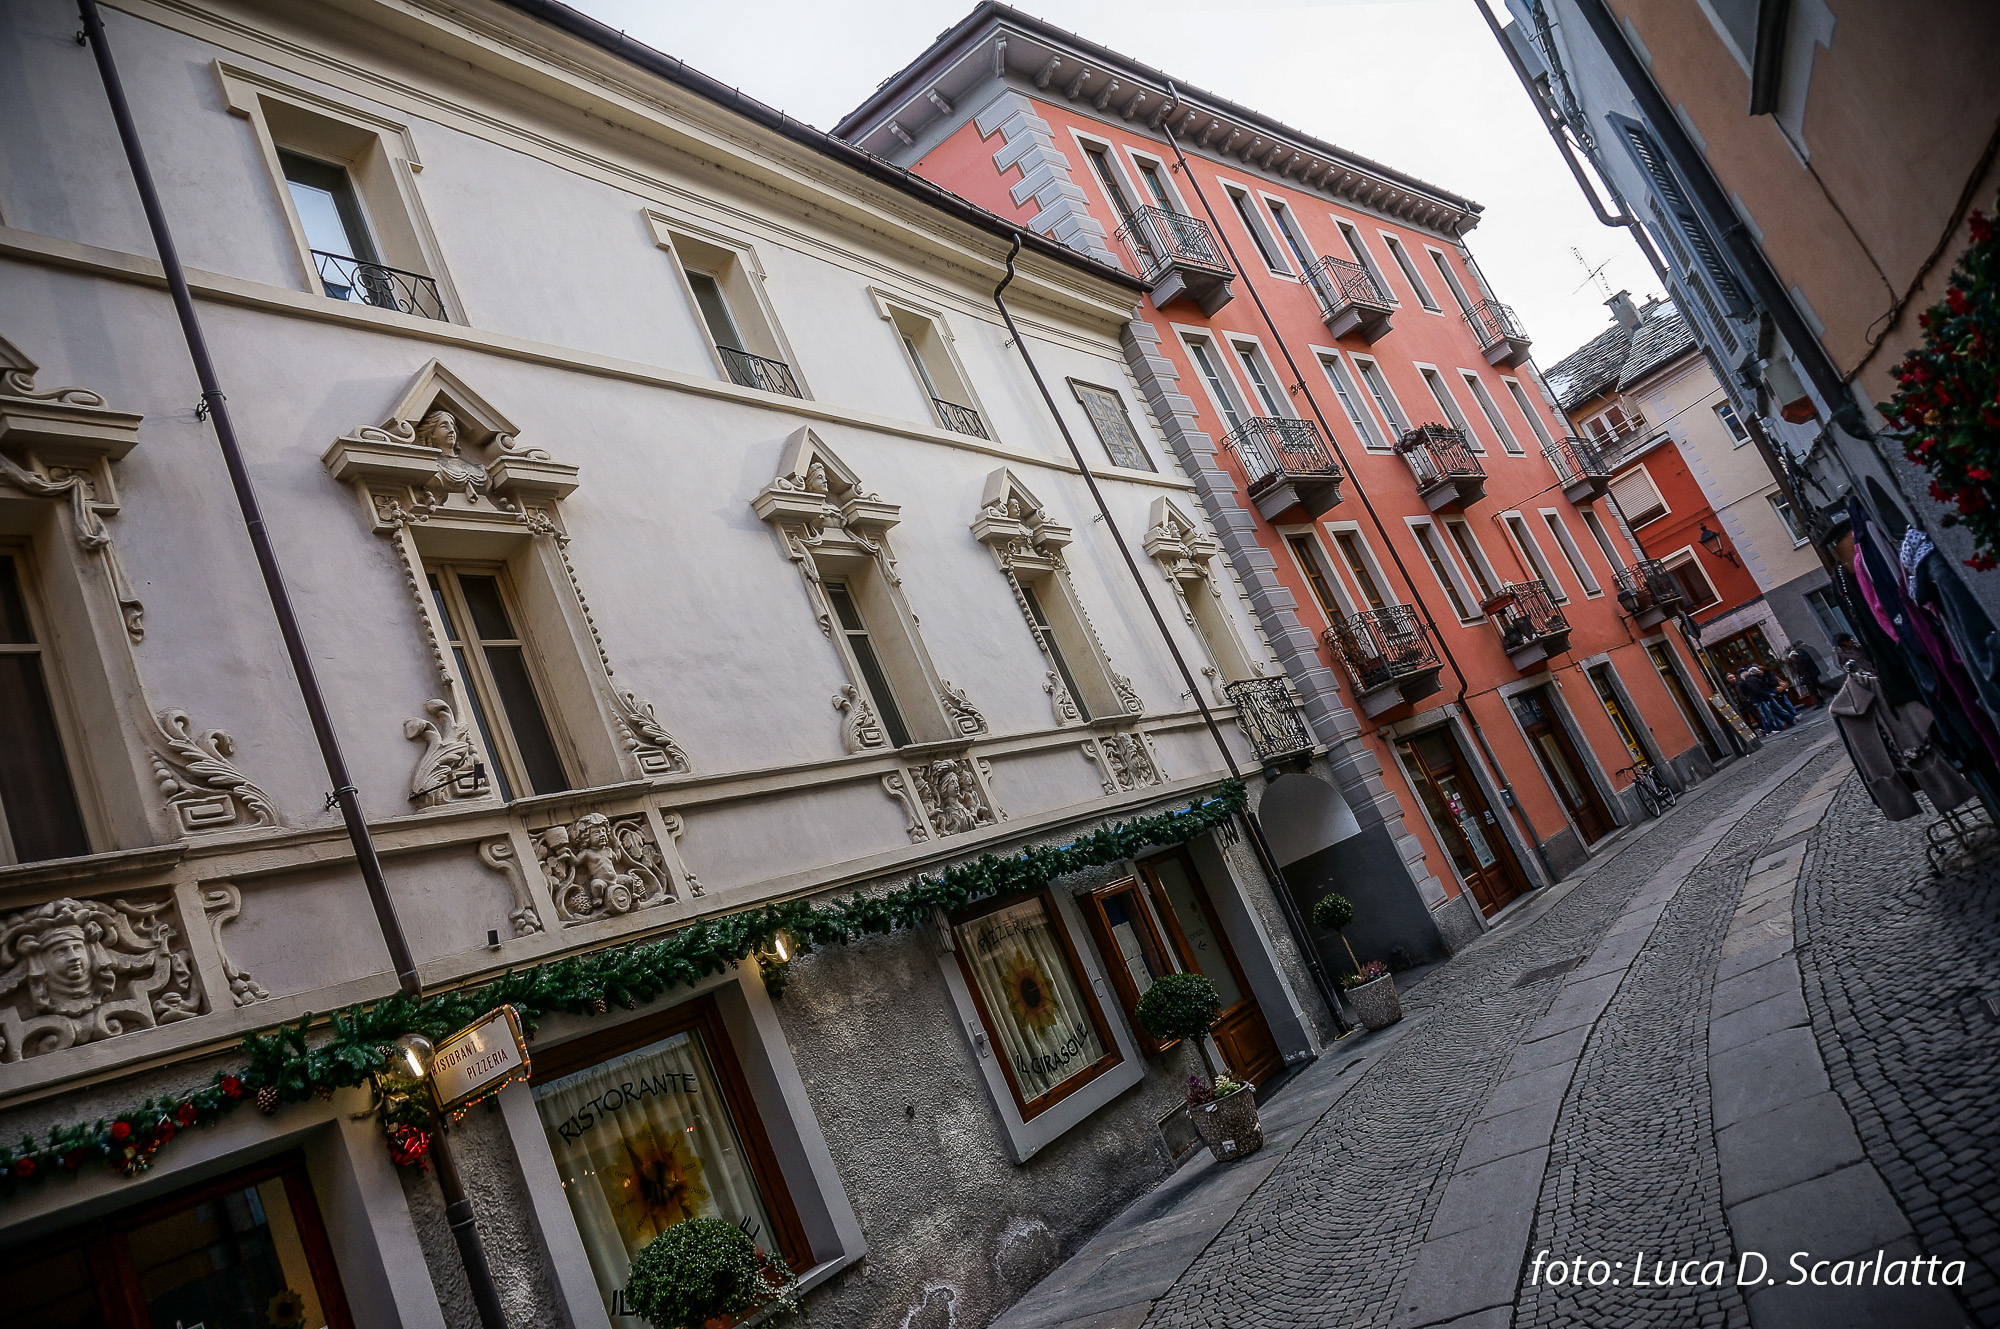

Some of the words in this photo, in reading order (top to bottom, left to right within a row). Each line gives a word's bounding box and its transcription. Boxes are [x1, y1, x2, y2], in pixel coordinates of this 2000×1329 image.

[978, 921, 1036, 954] PIZZERIA
[466, 1048, 509, 1080] PIZZERIA
[1016, 1055, 1030, 1074] IL
[1031, 1022, 1089, 1074] GIRASOLE
[558, 1073, 697, 1146] RISTORANTE
[681, 1162, 697, 1173] pizza
